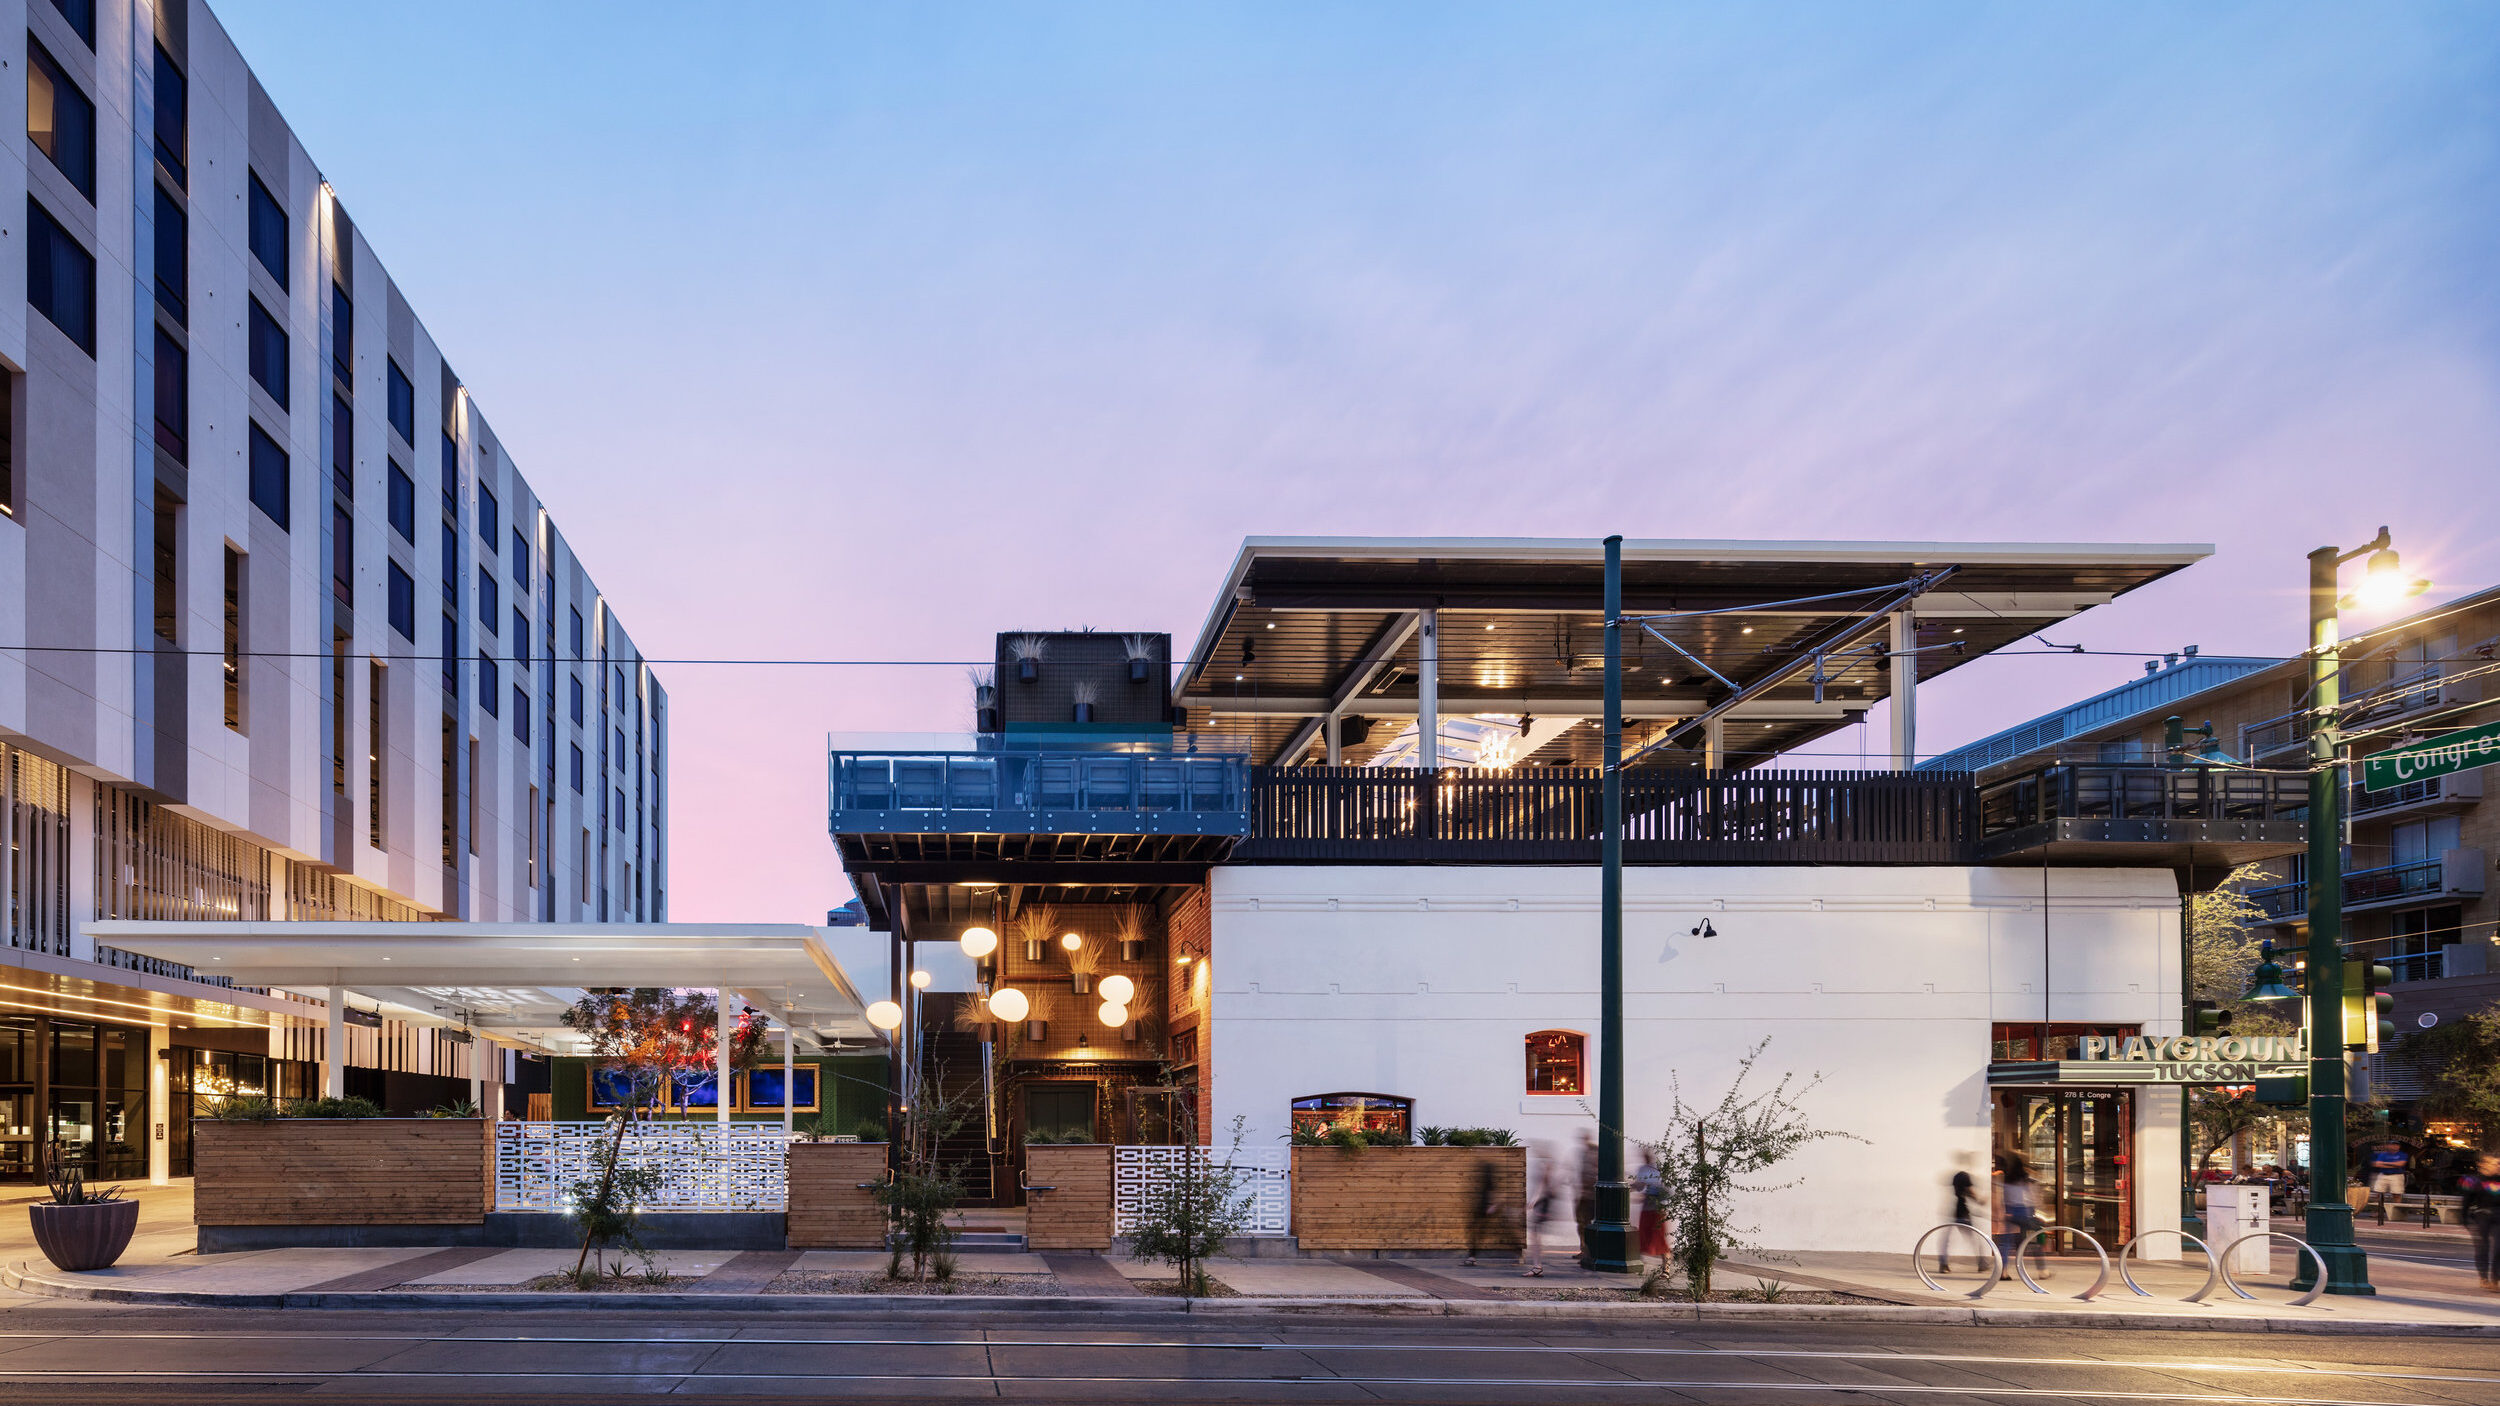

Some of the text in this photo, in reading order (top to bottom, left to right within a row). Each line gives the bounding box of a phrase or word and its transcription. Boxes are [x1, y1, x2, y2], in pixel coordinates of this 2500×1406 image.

[2373, 733, 2500, 780] E Congre
[2085, 1036, 2302, 1061] PLAYGROUN
[2156, 1063, 2256, 1081] TUCSON
[2087, 1091, 2112, 1100] Congre
